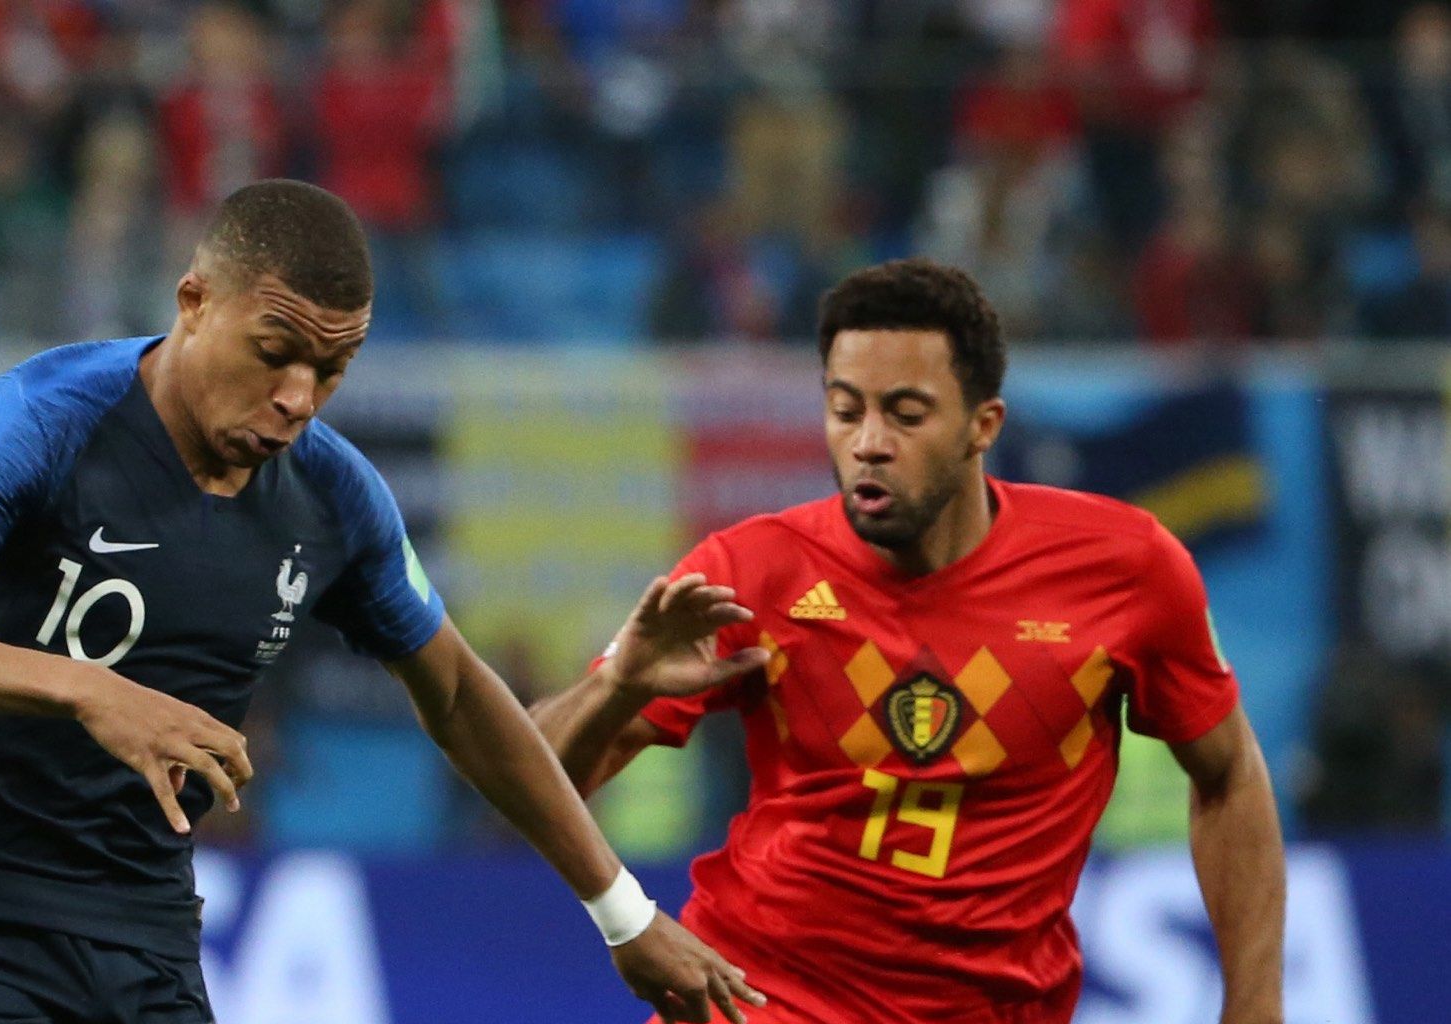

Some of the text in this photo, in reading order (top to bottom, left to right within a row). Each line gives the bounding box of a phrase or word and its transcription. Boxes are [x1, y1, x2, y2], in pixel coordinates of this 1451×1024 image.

[35, 557, 145, 667] 10
[789, 606, 847, 621] adidas
[858, 767, 966, 879] 19
